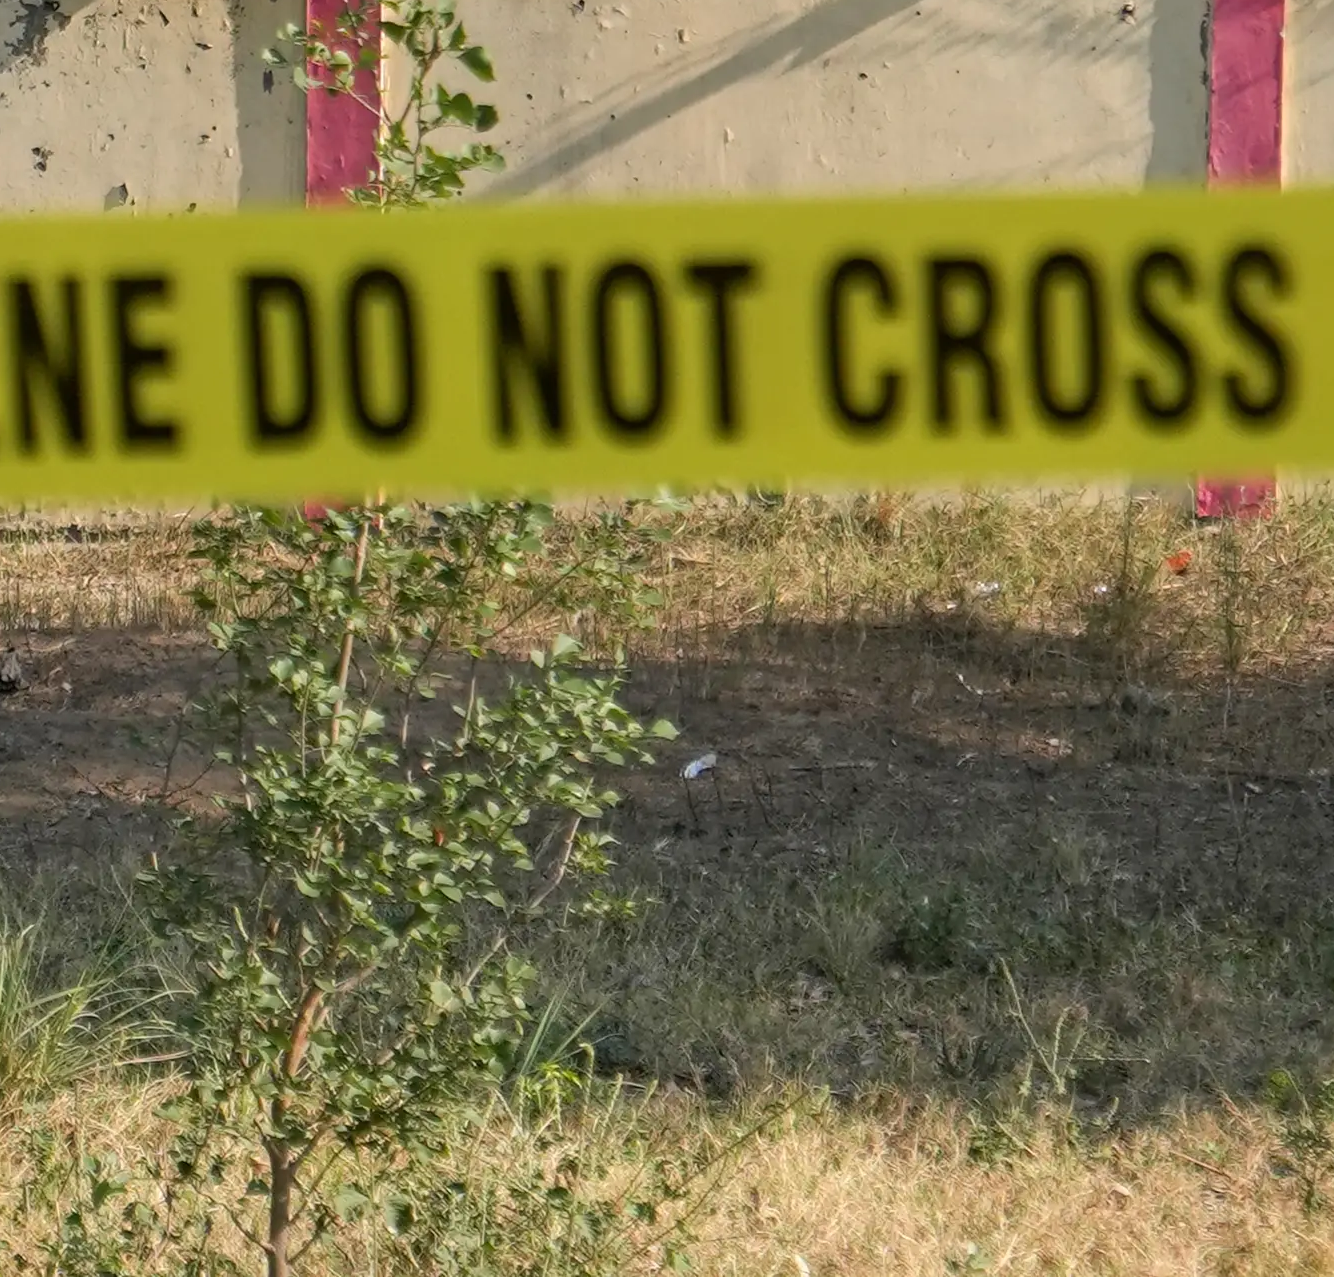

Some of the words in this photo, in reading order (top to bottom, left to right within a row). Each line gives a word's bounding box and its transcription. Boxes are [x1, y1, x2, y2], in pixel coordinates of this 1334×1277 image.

[238, 262, 425, 452] DO
[485, 256, 760, 446] NOT
[819, 242, 1295, 439] CROSS
